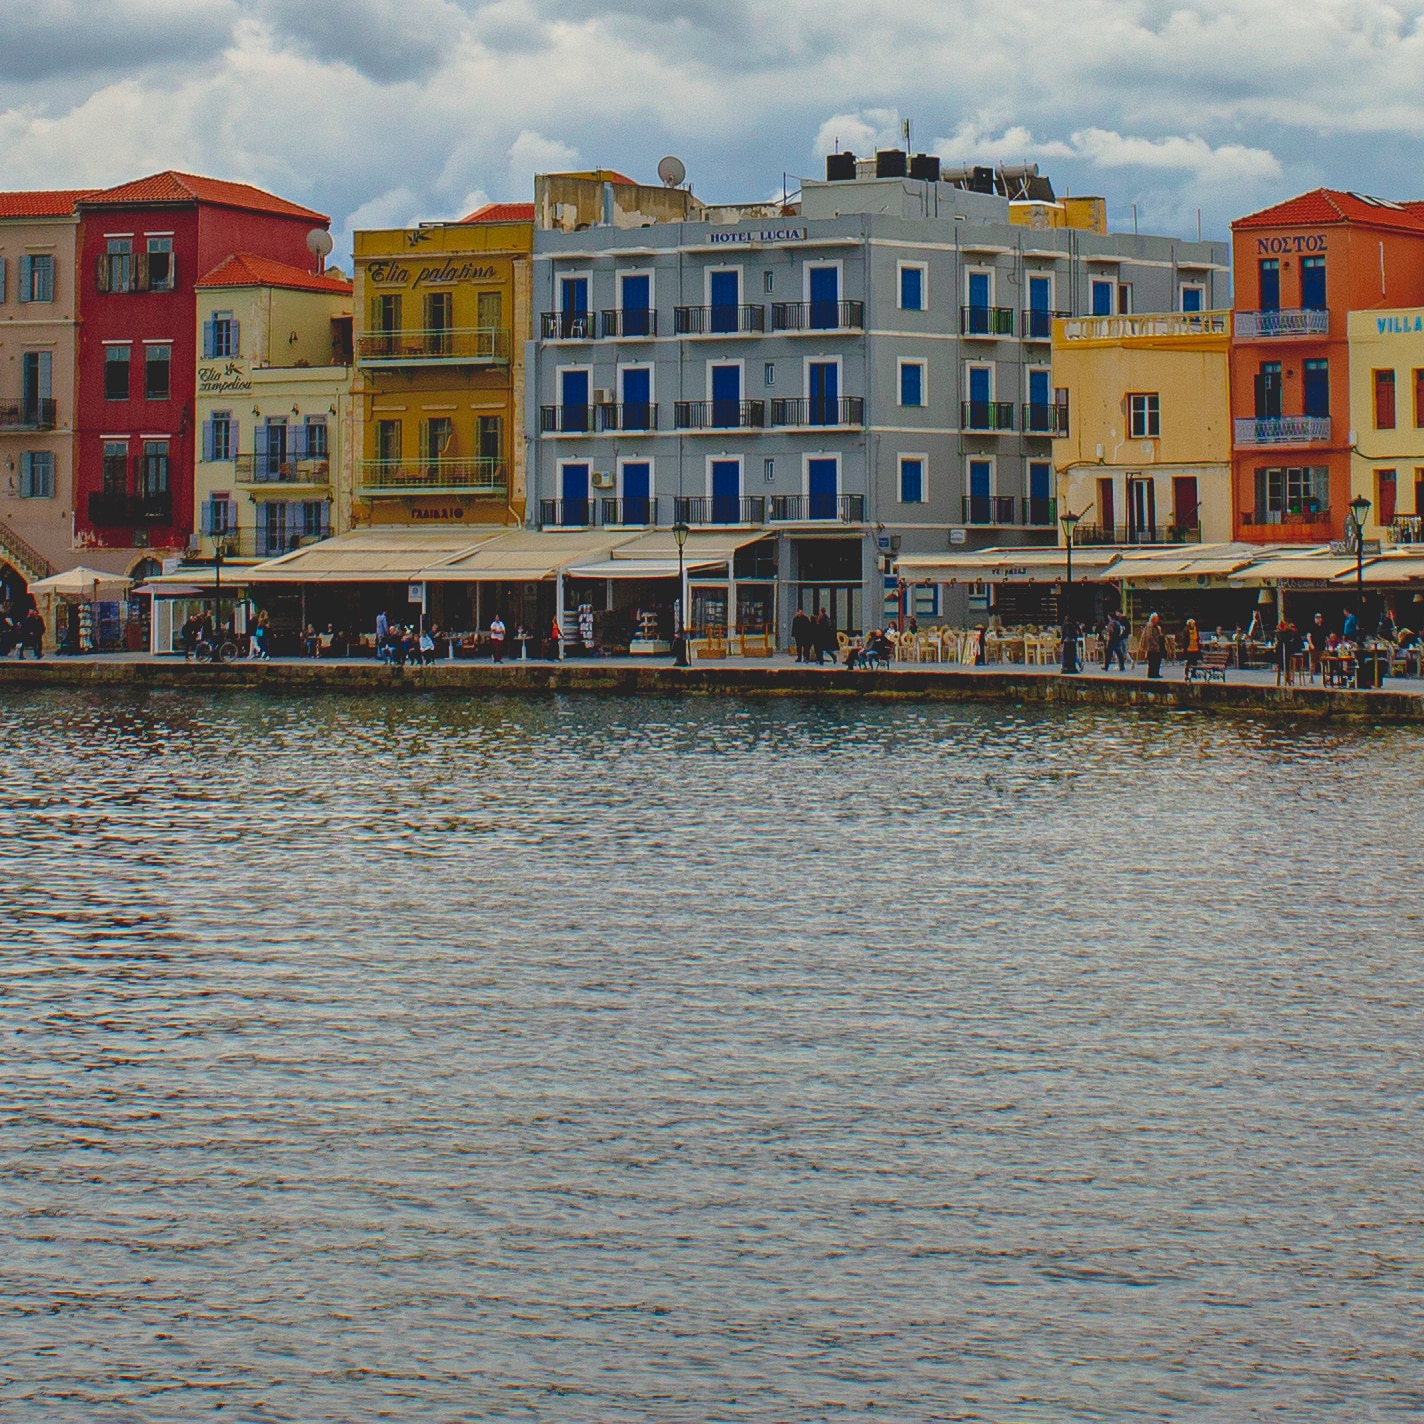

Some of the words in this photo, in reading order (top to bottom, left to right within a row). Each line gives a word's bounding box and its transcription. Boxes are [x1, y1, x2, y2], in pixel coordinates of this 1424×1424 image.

[710, 231, 755, 243] HOTEL
[760, 229, 800, 241] LUCIA
[1256, 235, 1328, 255] ΝΟΣΤΟΣ
[367, 260, 409, 283] Elia
[1376, 316, 1423, 334] VILLA
